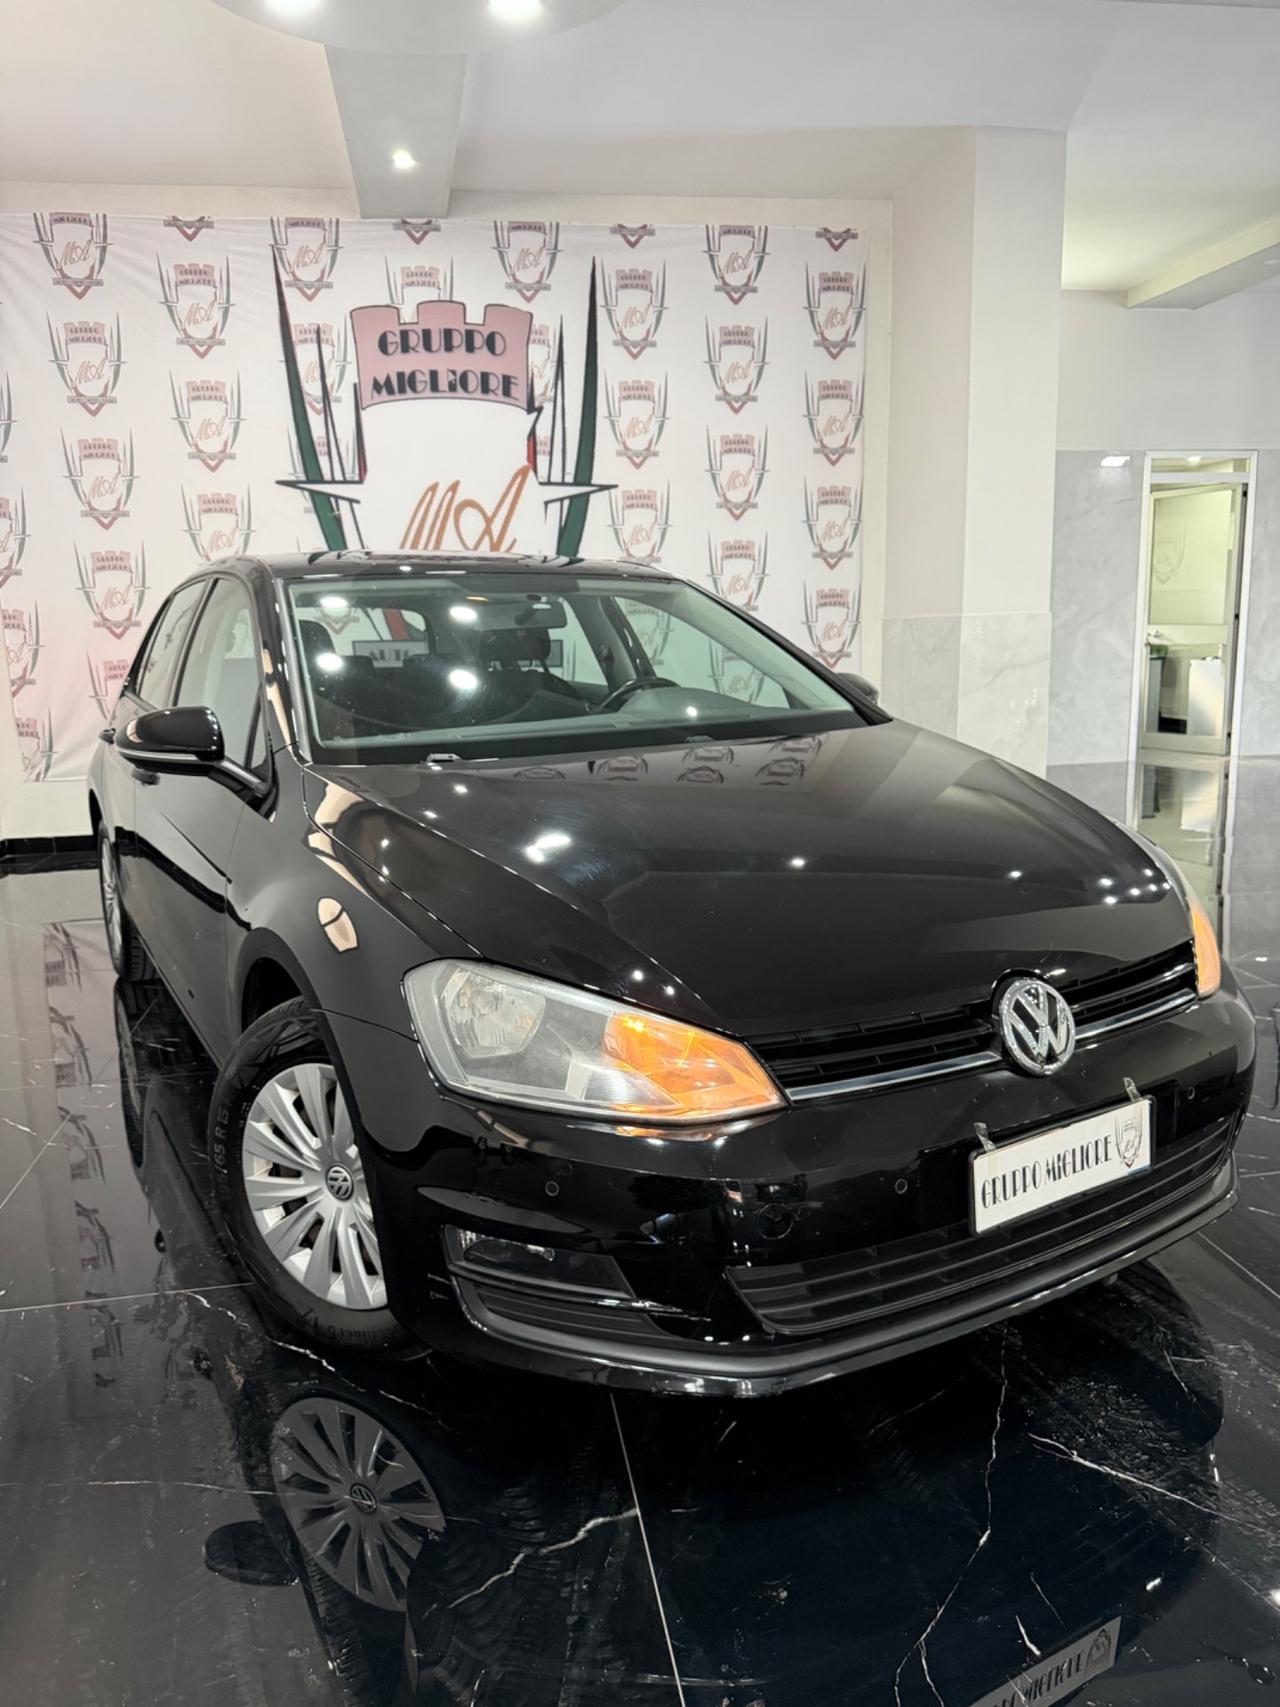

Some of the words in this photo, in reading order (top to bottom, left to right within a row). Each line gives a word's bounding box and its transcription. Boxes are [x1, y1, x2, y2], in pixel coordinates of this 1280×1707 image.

[378, 327, 507, 357] GRUPPO
[371, 368, 519, 401] MIGLIORE
[981, 1160, 1042, 1209] GRUPPO
[1044, 1134, 1112, 1185] MIGLIORE
